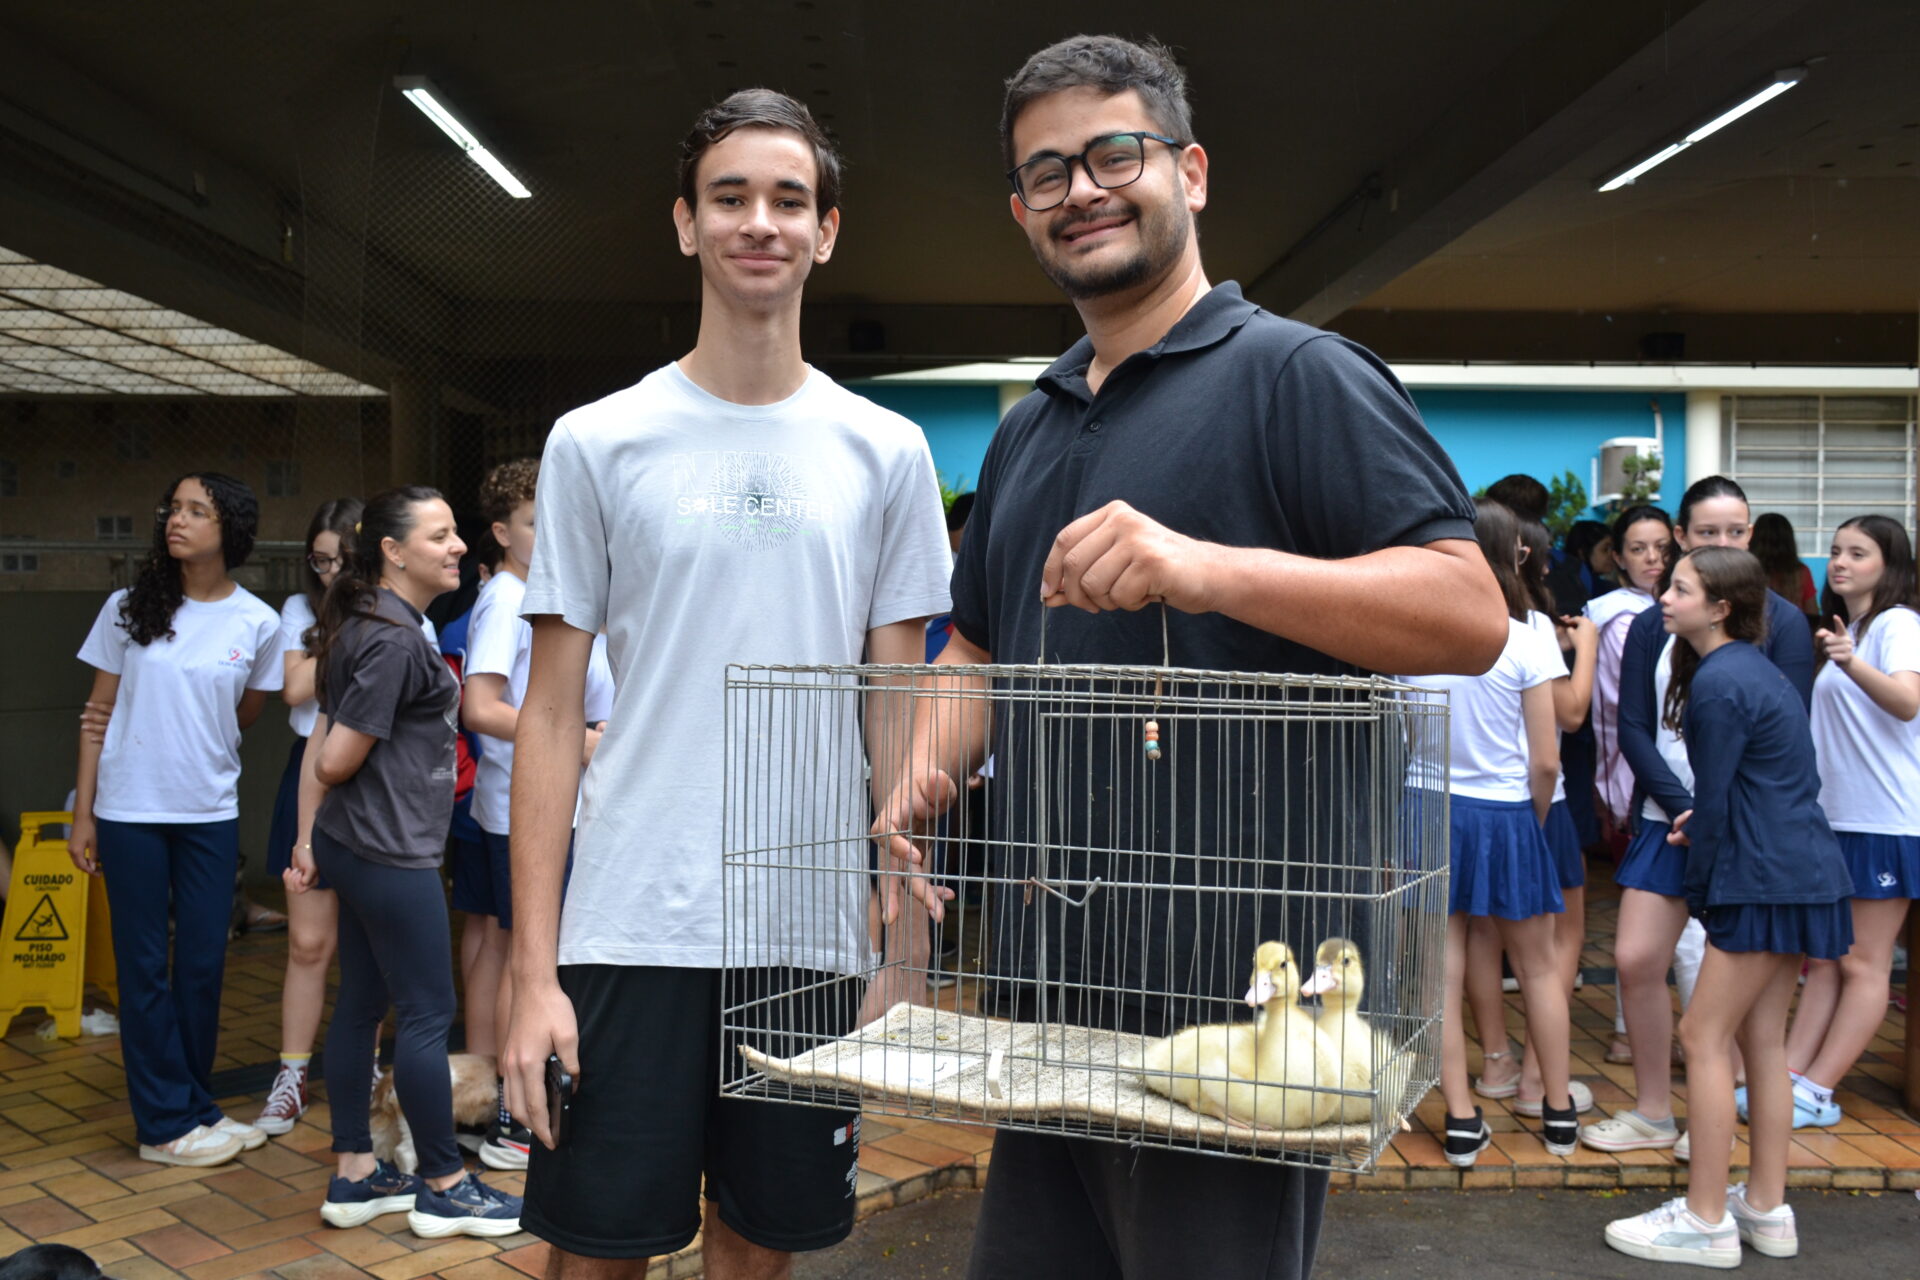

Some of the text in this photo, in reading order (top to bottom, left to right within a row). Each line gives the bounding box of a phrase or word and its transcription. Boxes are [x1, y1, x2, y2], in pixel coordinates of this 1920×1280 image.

[745, 497, 833, 521] CENTER
[24, 875, 73, 885] CUIDADO
[29, 943, 53, 953] PISO
[13, 953, 66, 963] MOLHADO
